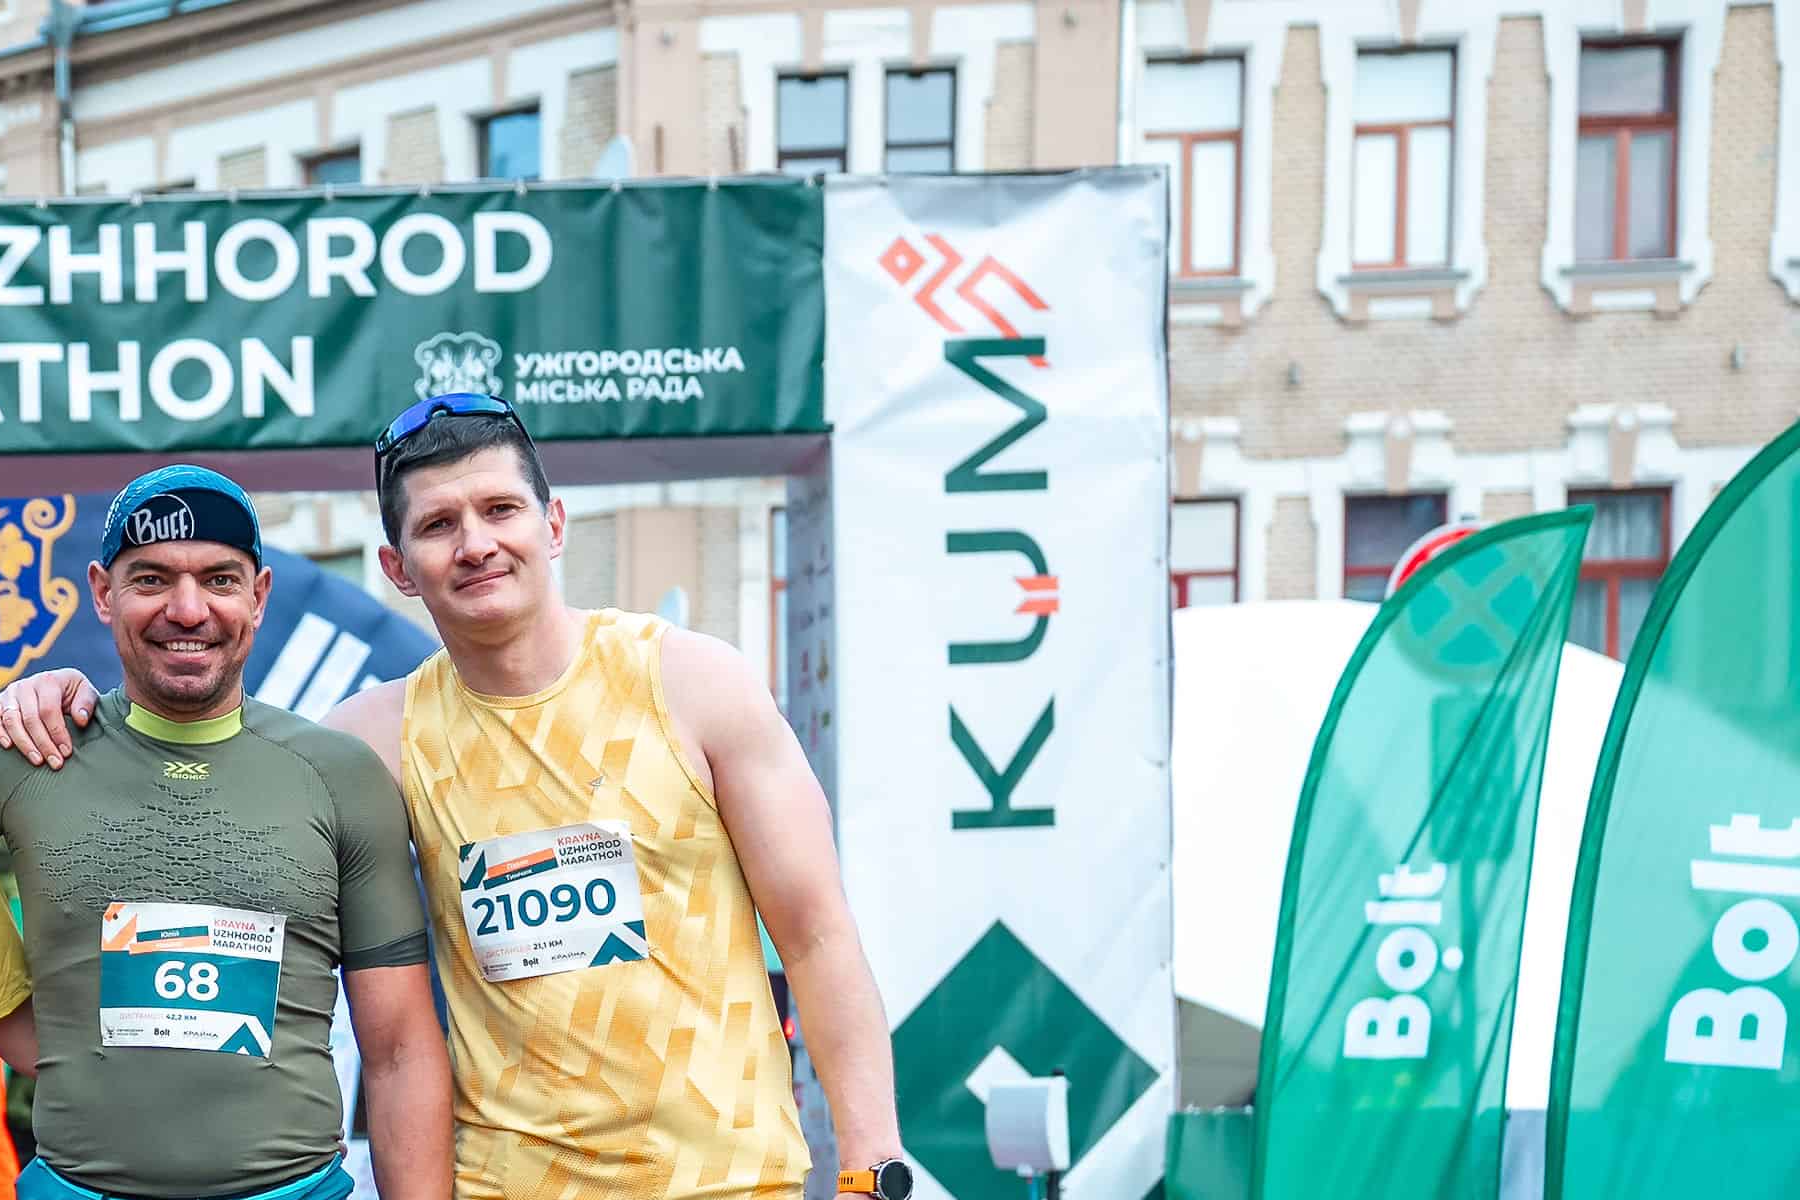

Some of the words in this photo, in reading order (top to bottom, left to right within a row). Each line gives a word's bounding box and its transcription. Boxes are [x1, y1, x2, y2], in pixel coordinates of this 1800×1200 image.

[514, 346, 745, 379] УЖГОРОДСЬКА
[516, 378, 622, 404] МІСЬКА
[626, 375, 705, 402] РАДА
[557, 832, 601, 847] KRAYNA
[559, 839, 622, 858] UZHHOROD
[560, 849, 623, 867] MARATHON
[471, 877, 617, 937] 21090
[213, 918, 257, 932] KRAYNA
[213, 928, 273, 944] UZHHOROD
[1664, 813, 1800, 1070] Bolt
[212, 938, 272, 954] MARATHON
[523, 958, 539, 969] Bolt
[1343, 861, 1452, 1059] Bolt
[154, 960, 219, 1002] 68
[165, 1012, 183, 1021] 42,2
[153, 1026, 171, 1038] Bolt
